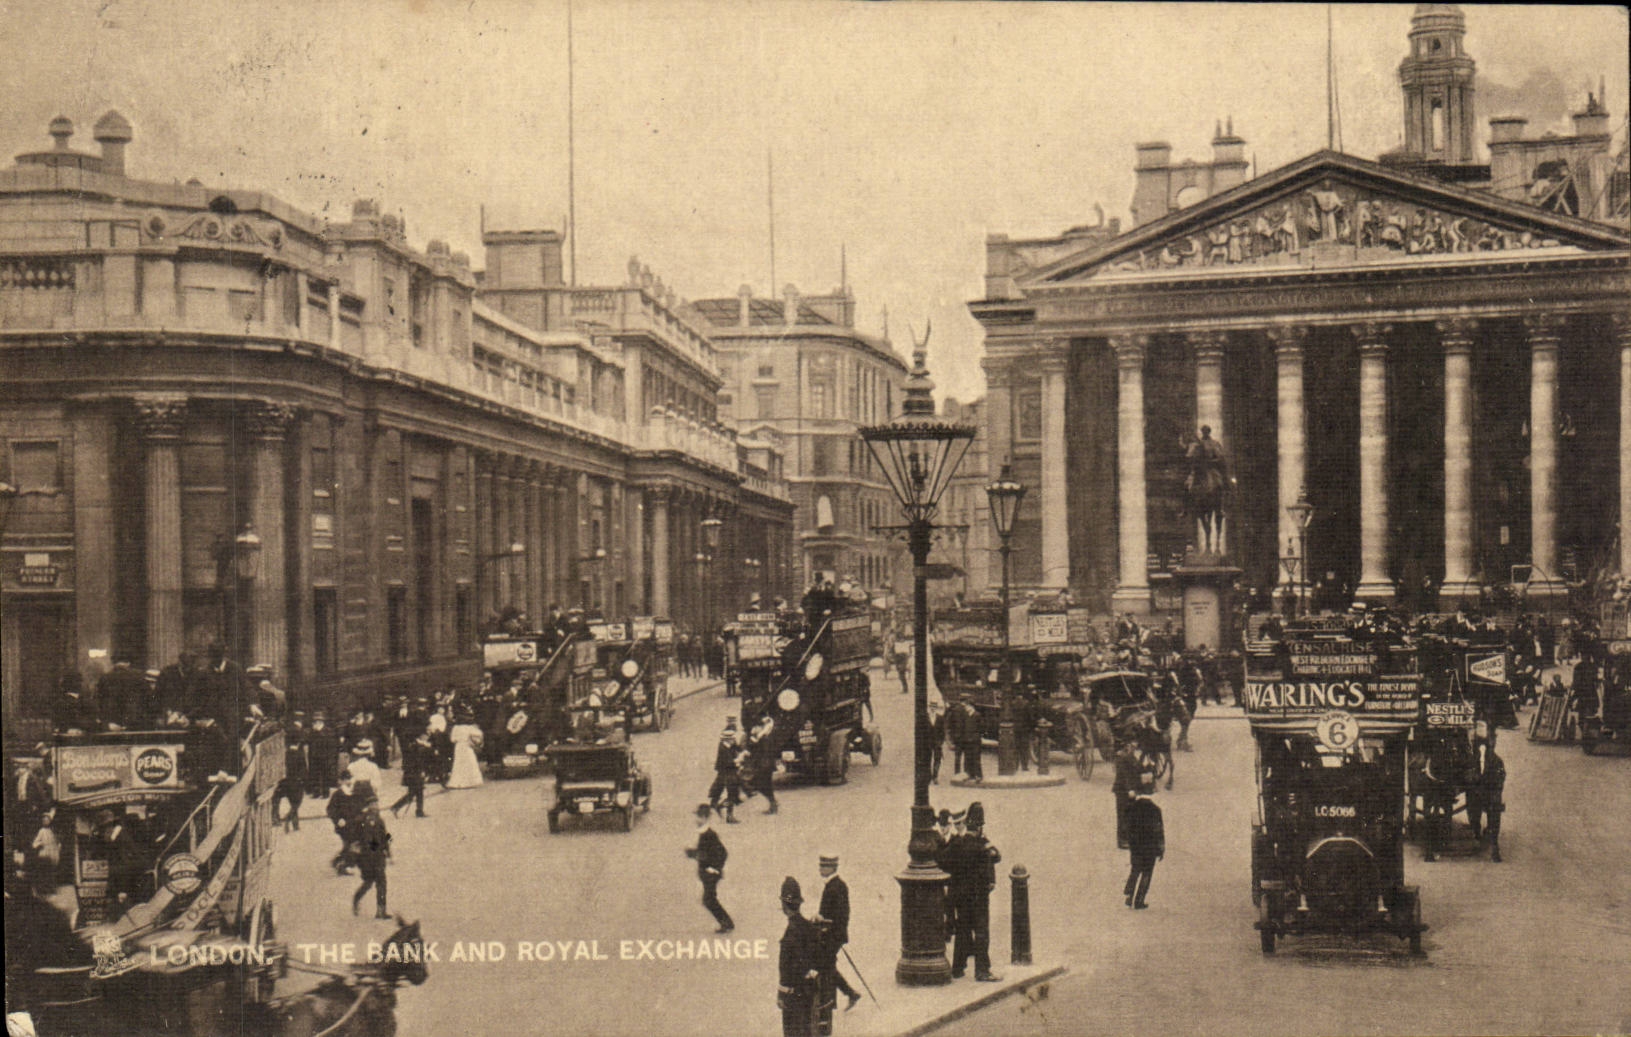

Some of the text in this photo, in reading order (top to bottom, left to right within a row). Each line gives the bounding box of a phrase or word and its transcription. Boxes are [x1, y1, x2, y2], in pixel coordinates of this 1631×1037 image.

[1341, 641, 1375, 653] RISE
[1247, 680, 1365, 708] WARING'S
[1329, 722, 1347, 745] 6
